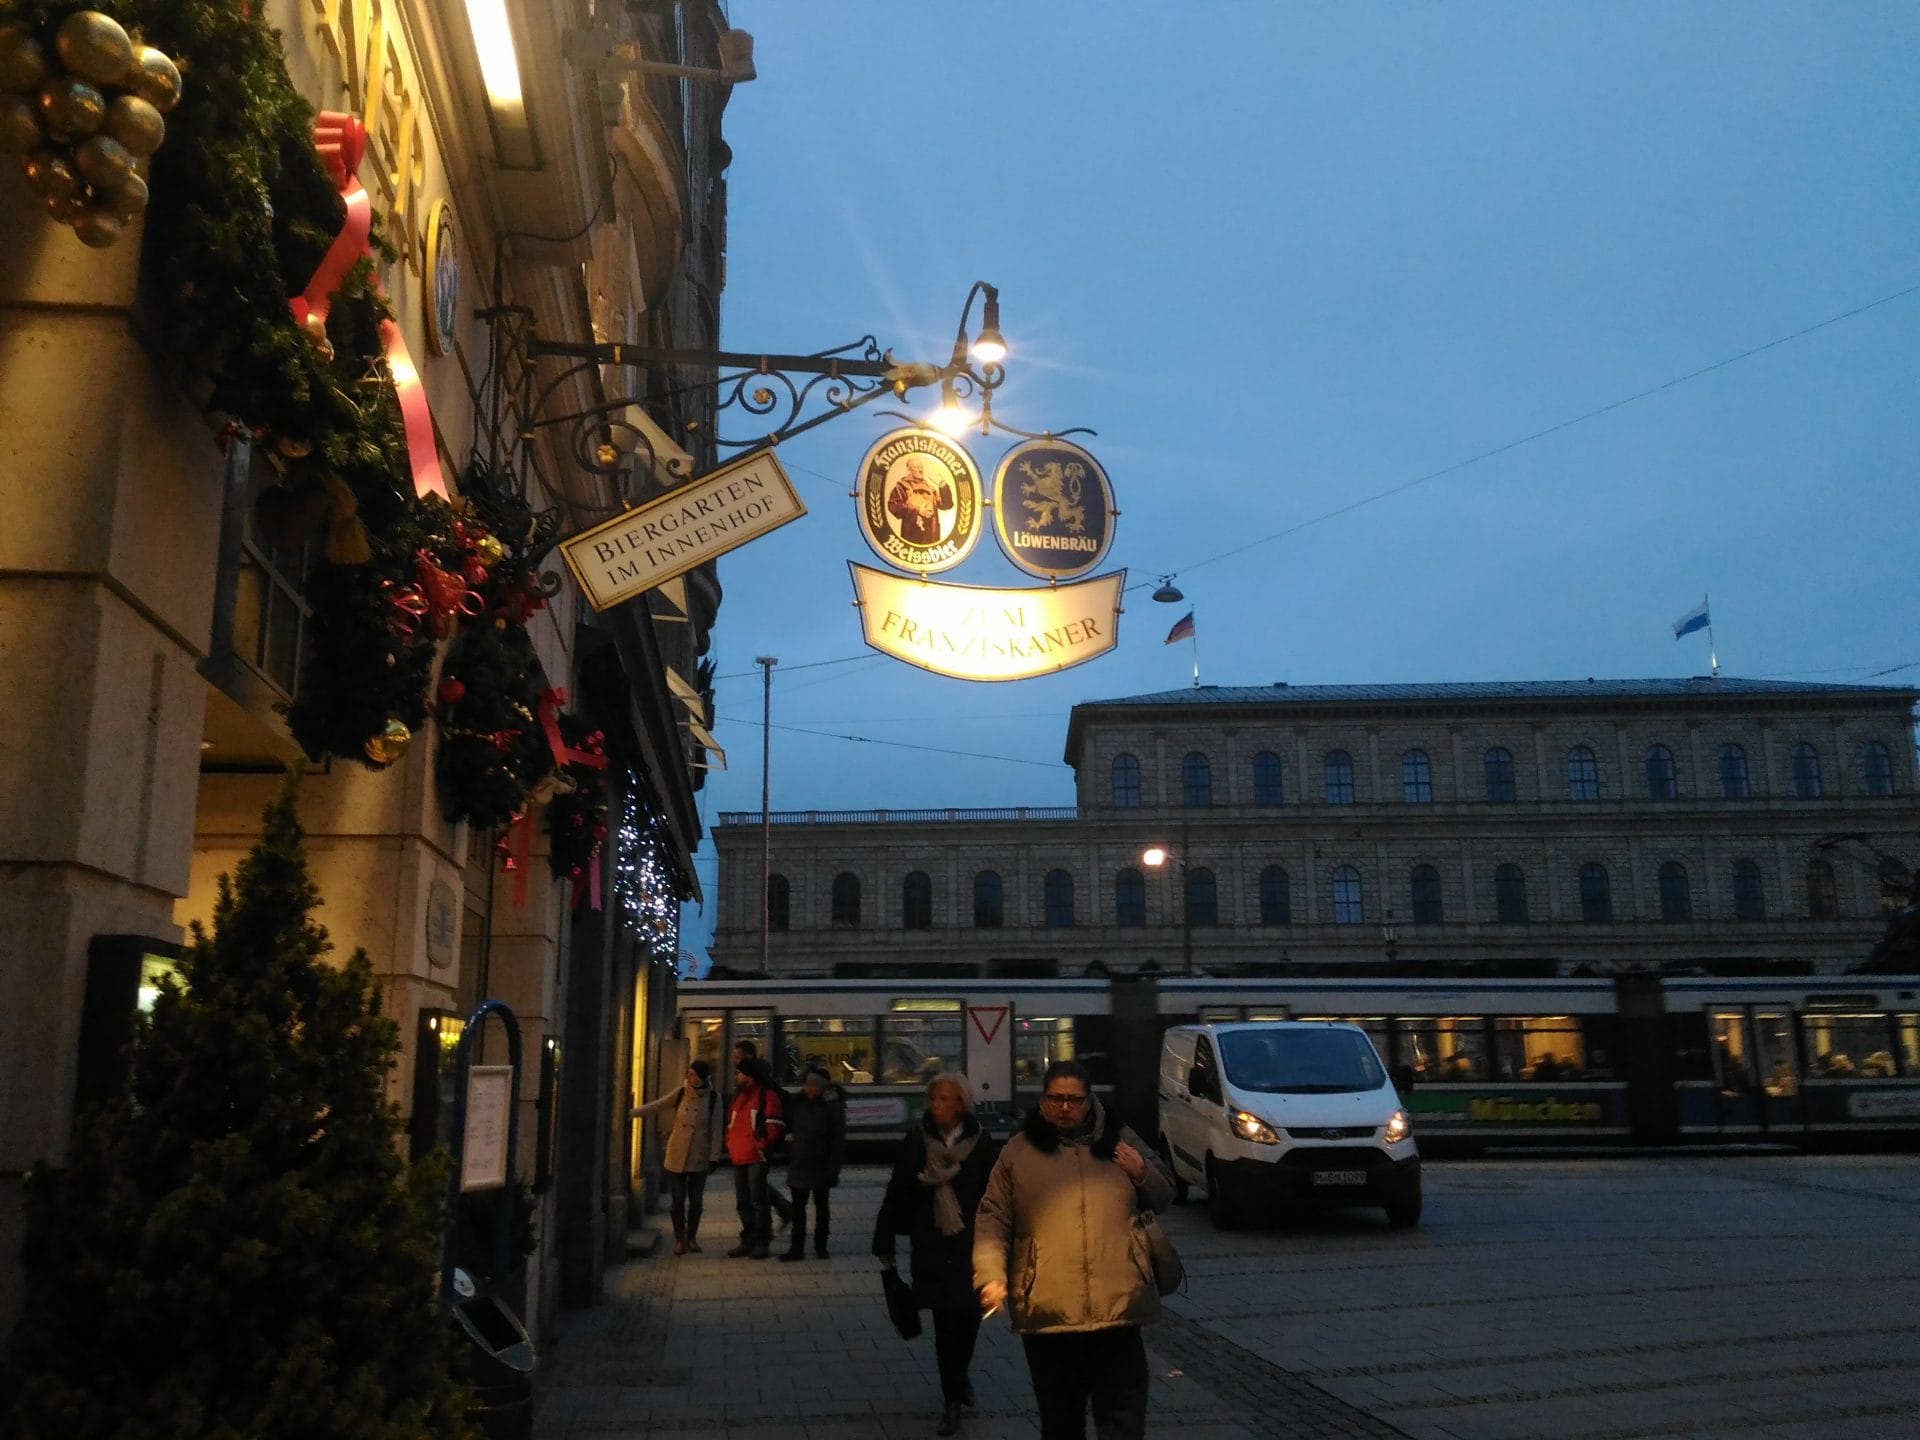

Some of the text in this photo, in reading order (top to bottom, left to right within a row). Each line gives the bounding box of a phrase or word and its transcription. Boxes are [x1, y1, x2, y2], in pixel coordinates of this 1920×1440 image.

[875, 436, 967, 478] Franziskaner
[593, 472, 766, 563] BIERGARTEN
[607, 494, 775, 586] IM INNENHOF
[882, 534, 959, 565] Weissbier
[1014, 531, 1098, 552] LÖWENBRÄU
[880, 610, 1102, 657] FRANZISKANER
